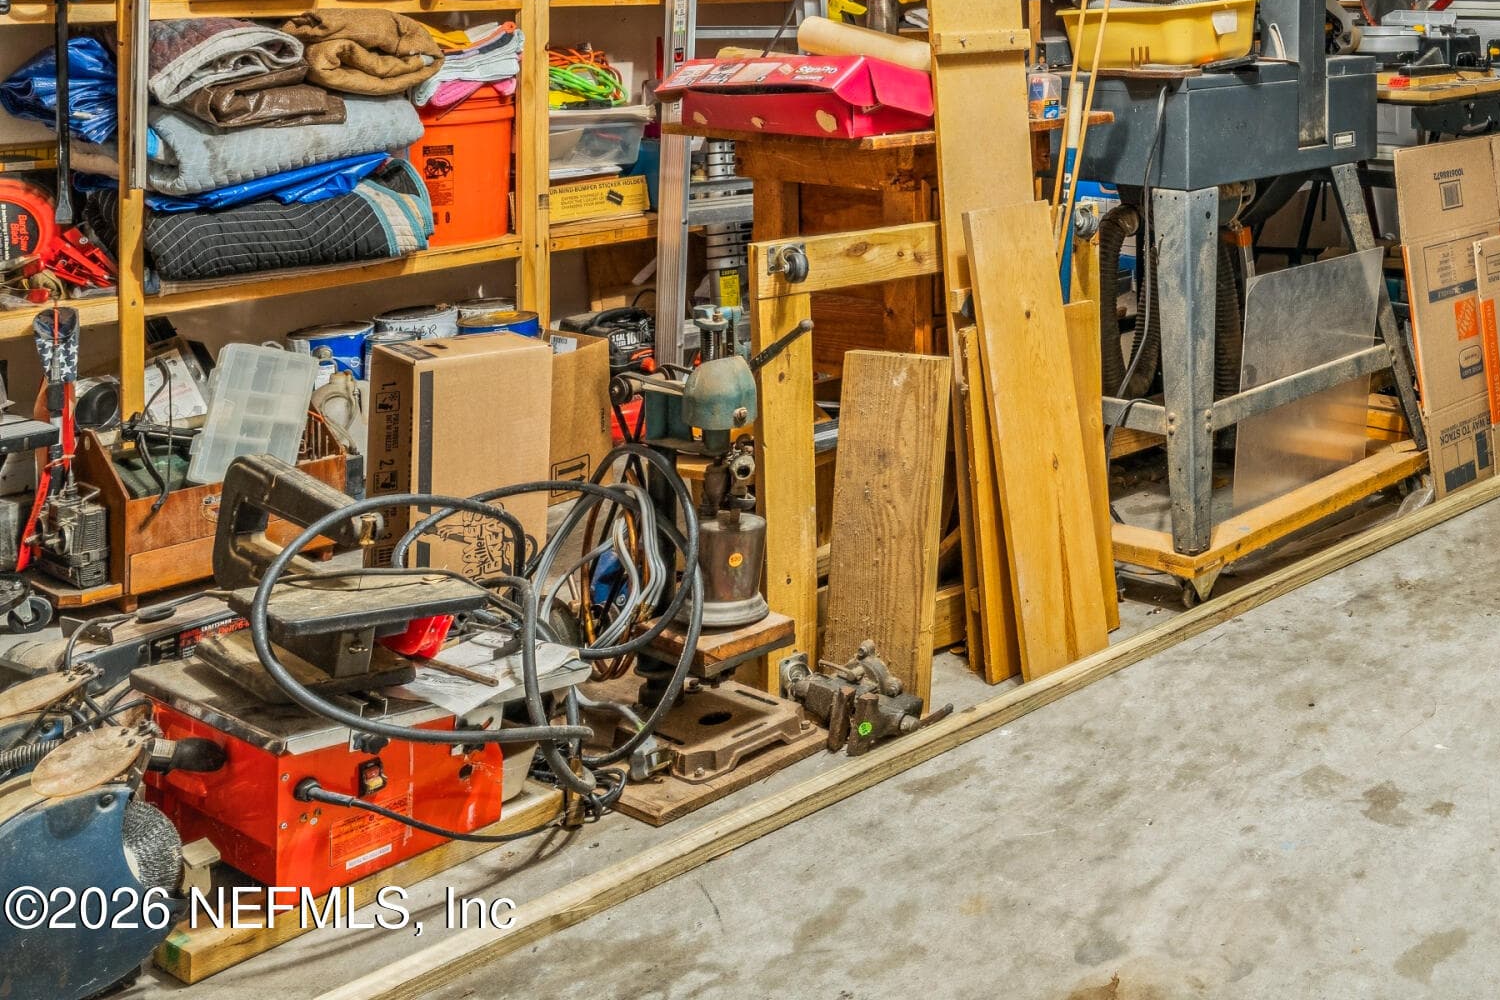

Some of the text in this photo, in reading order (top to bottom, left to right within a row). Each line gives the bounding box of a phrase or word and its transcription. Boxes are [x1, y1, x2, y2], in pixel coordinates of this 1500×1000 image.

[574, 184, 598, 193] BUMPER
[10, 223, 19, 245] Blade
[18, 215, 29, 251] Band Saw
[1489, 342, 1498, 369] DUTY
[1440, 418, 1486, 446] WAY TO STACK
[475, 536, 490, 567] killer
